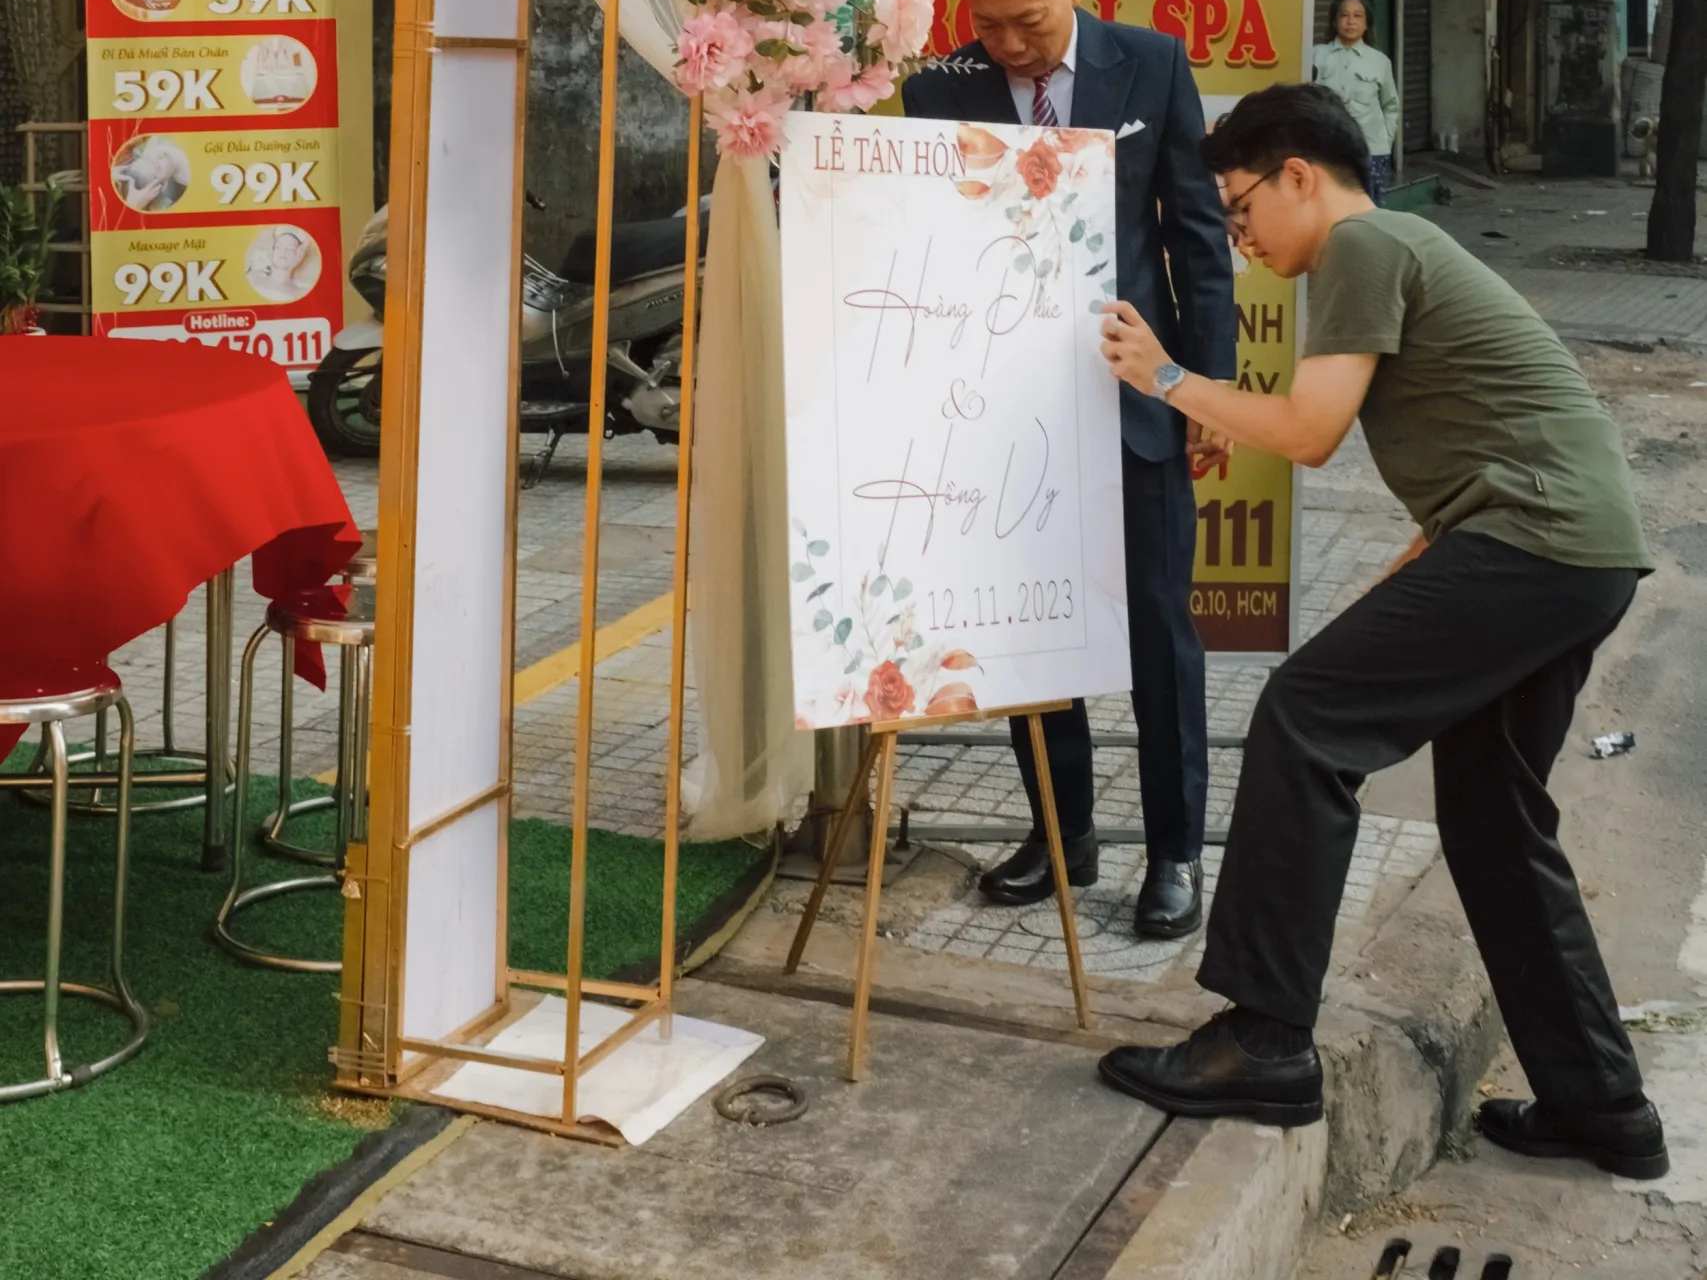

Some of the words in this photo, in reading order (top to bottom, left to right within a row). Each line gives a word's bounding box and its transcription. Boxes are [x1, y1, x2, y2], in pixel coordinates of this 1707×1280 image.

[112, 69, 225, 113] 59K
[813, 120, 845, 172] LỄ
[854, 128, 904, 174] TÂN
[913, 131, 967, 178] HÔN
[210, 160, 322, 205] 99K
[128, 240, 180, 254] Massage
[114, 259, 229, 306] 99K
[190, 313, 250, 330] Hotline:
[843, 235, 973, 383] Hoàng
[284, 330, 322, 362] 111
[941, 377, 986, 420] &
[852, 422, 987, 575] Hồng
[995, 416, 1061, 541] Vy
[928, 578, 1075, 632] 12.11.2023
[1237, 590, 1277, 616] HCM
